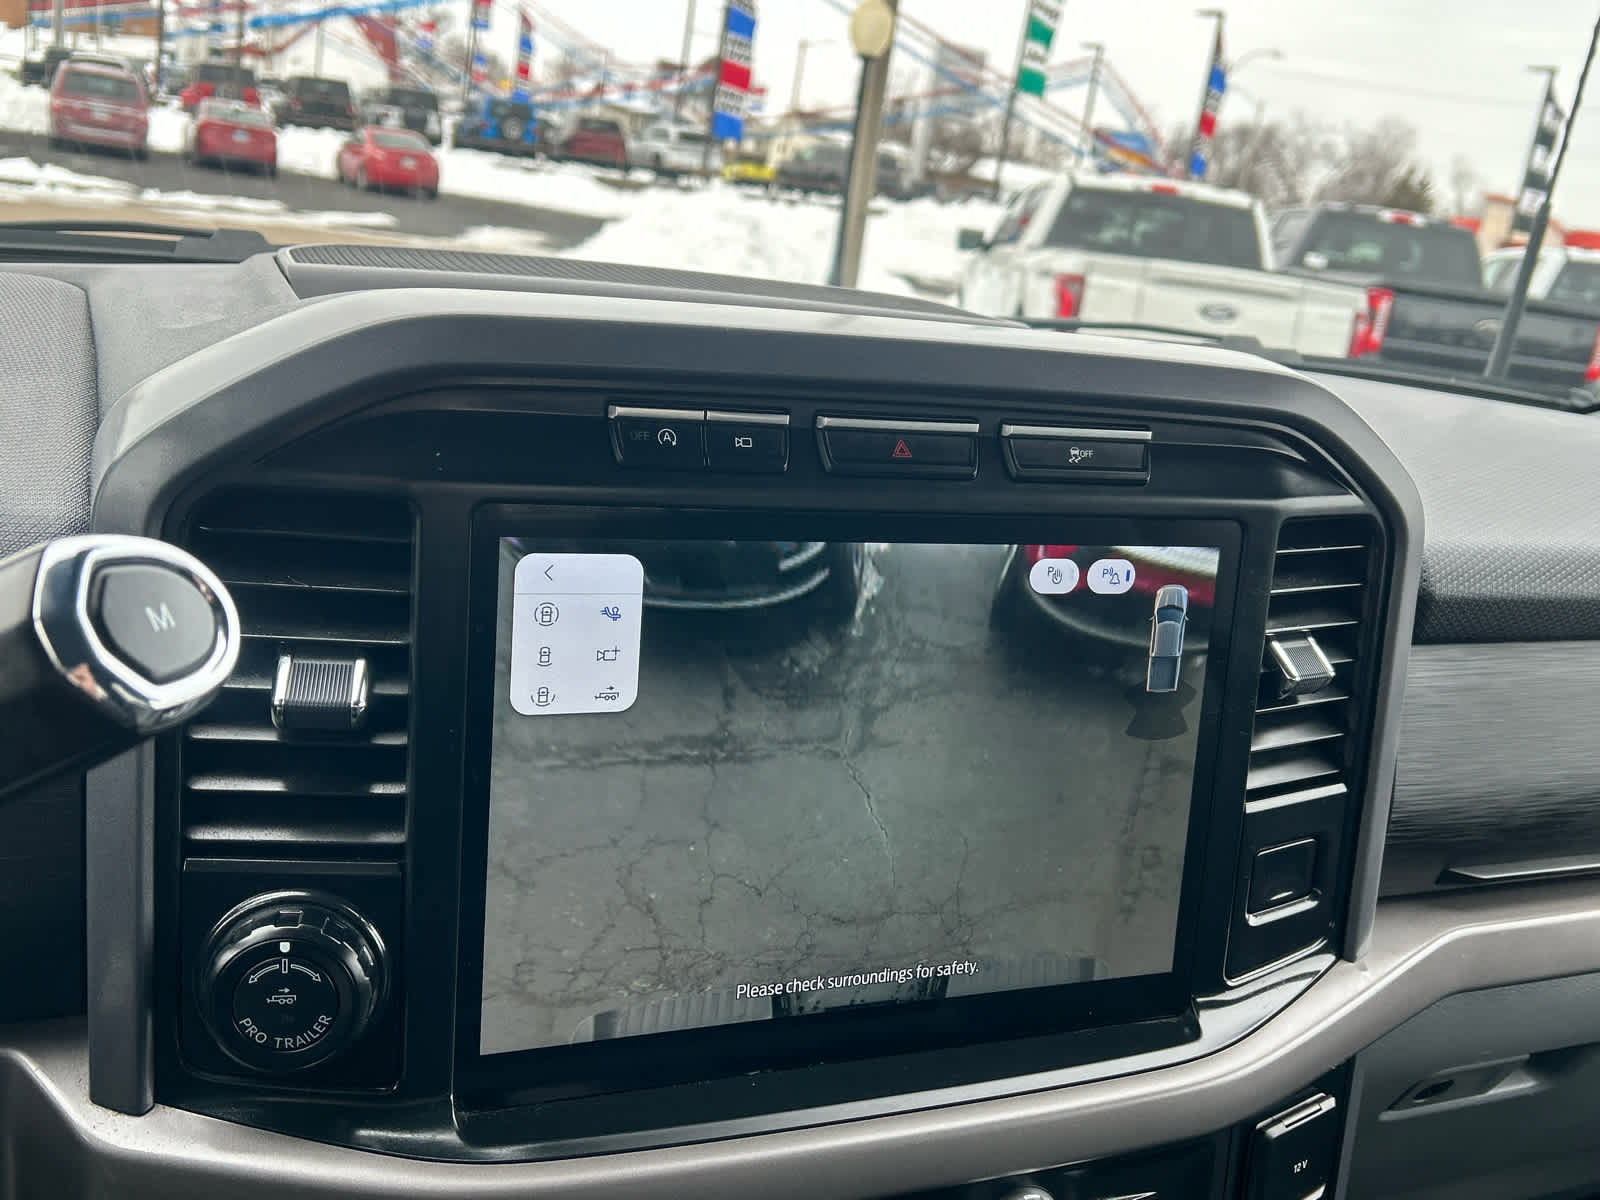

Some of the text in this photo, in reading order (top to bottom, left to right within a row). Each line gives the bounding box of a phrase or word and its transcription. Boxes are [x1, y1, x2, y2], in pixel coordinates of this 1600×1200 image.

[1080, 449, 1094, 458] OFF
[144, 602, 176, 633] M
[736, 960, 979, 1000] Please check surroundings for safety.
[239, 1014, 333, 1049] PRO TRAILER
